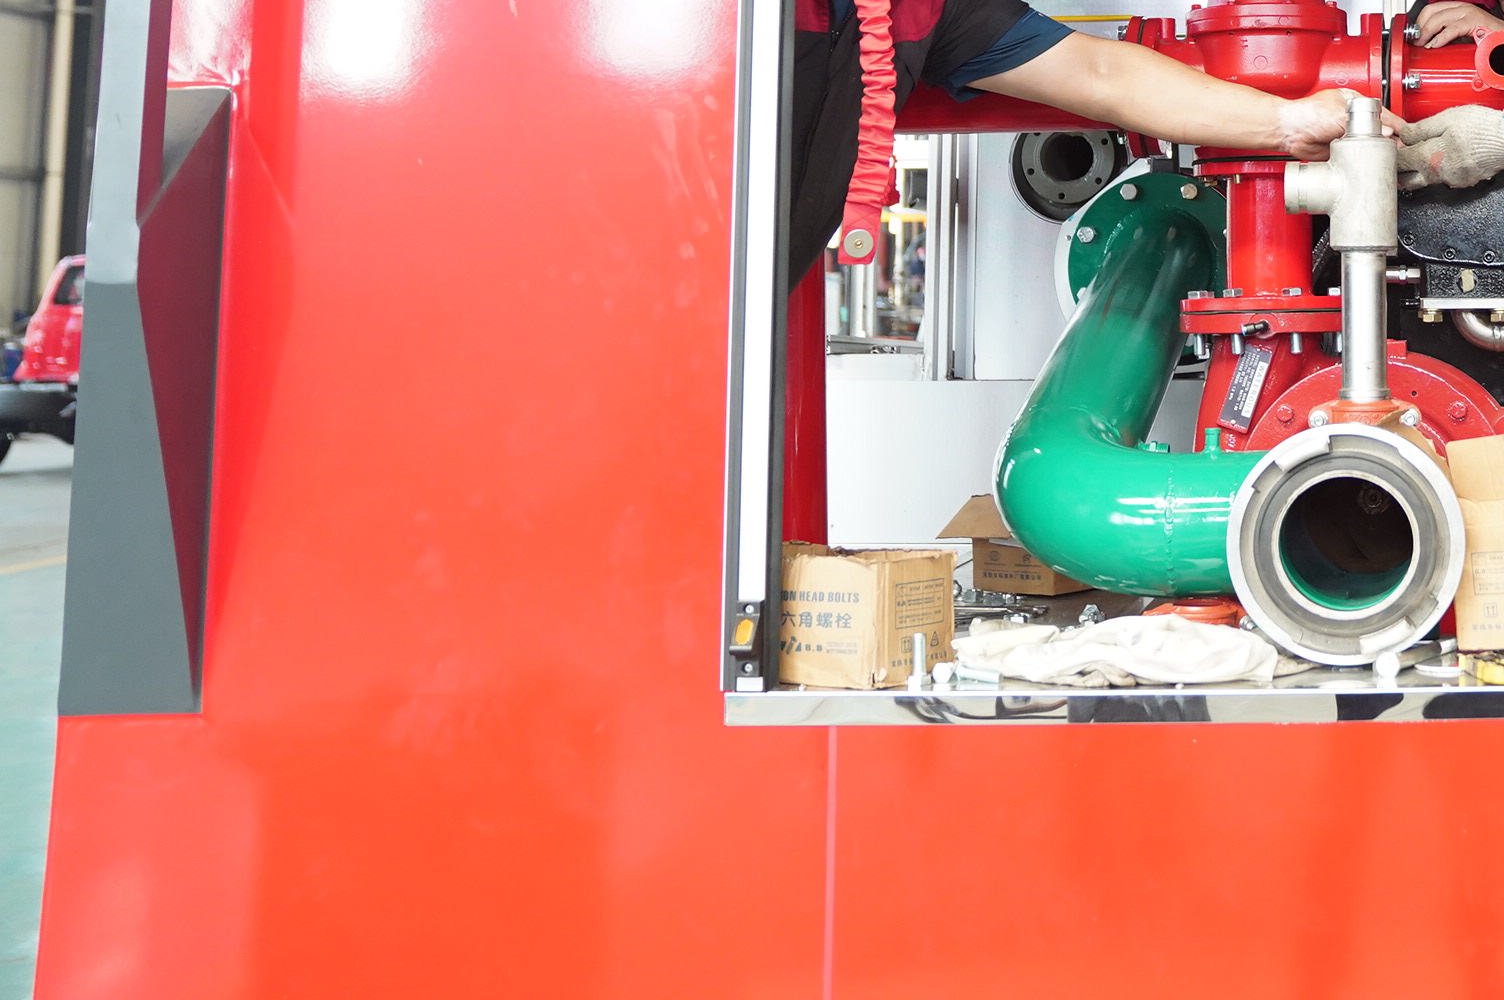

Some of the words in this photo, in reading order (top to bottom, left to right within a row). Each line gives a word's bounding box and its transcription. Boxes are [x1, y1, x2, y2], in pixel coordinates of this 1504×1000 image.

[1244, 365, 1266, 415] WATEROUS
[799, 591, 825, 602] HEAD
[827, 592, 860, 603] BOLTS
[781, 611, 852, 628] 六角螺栓
[805, 643, 823, 652] 8.8
